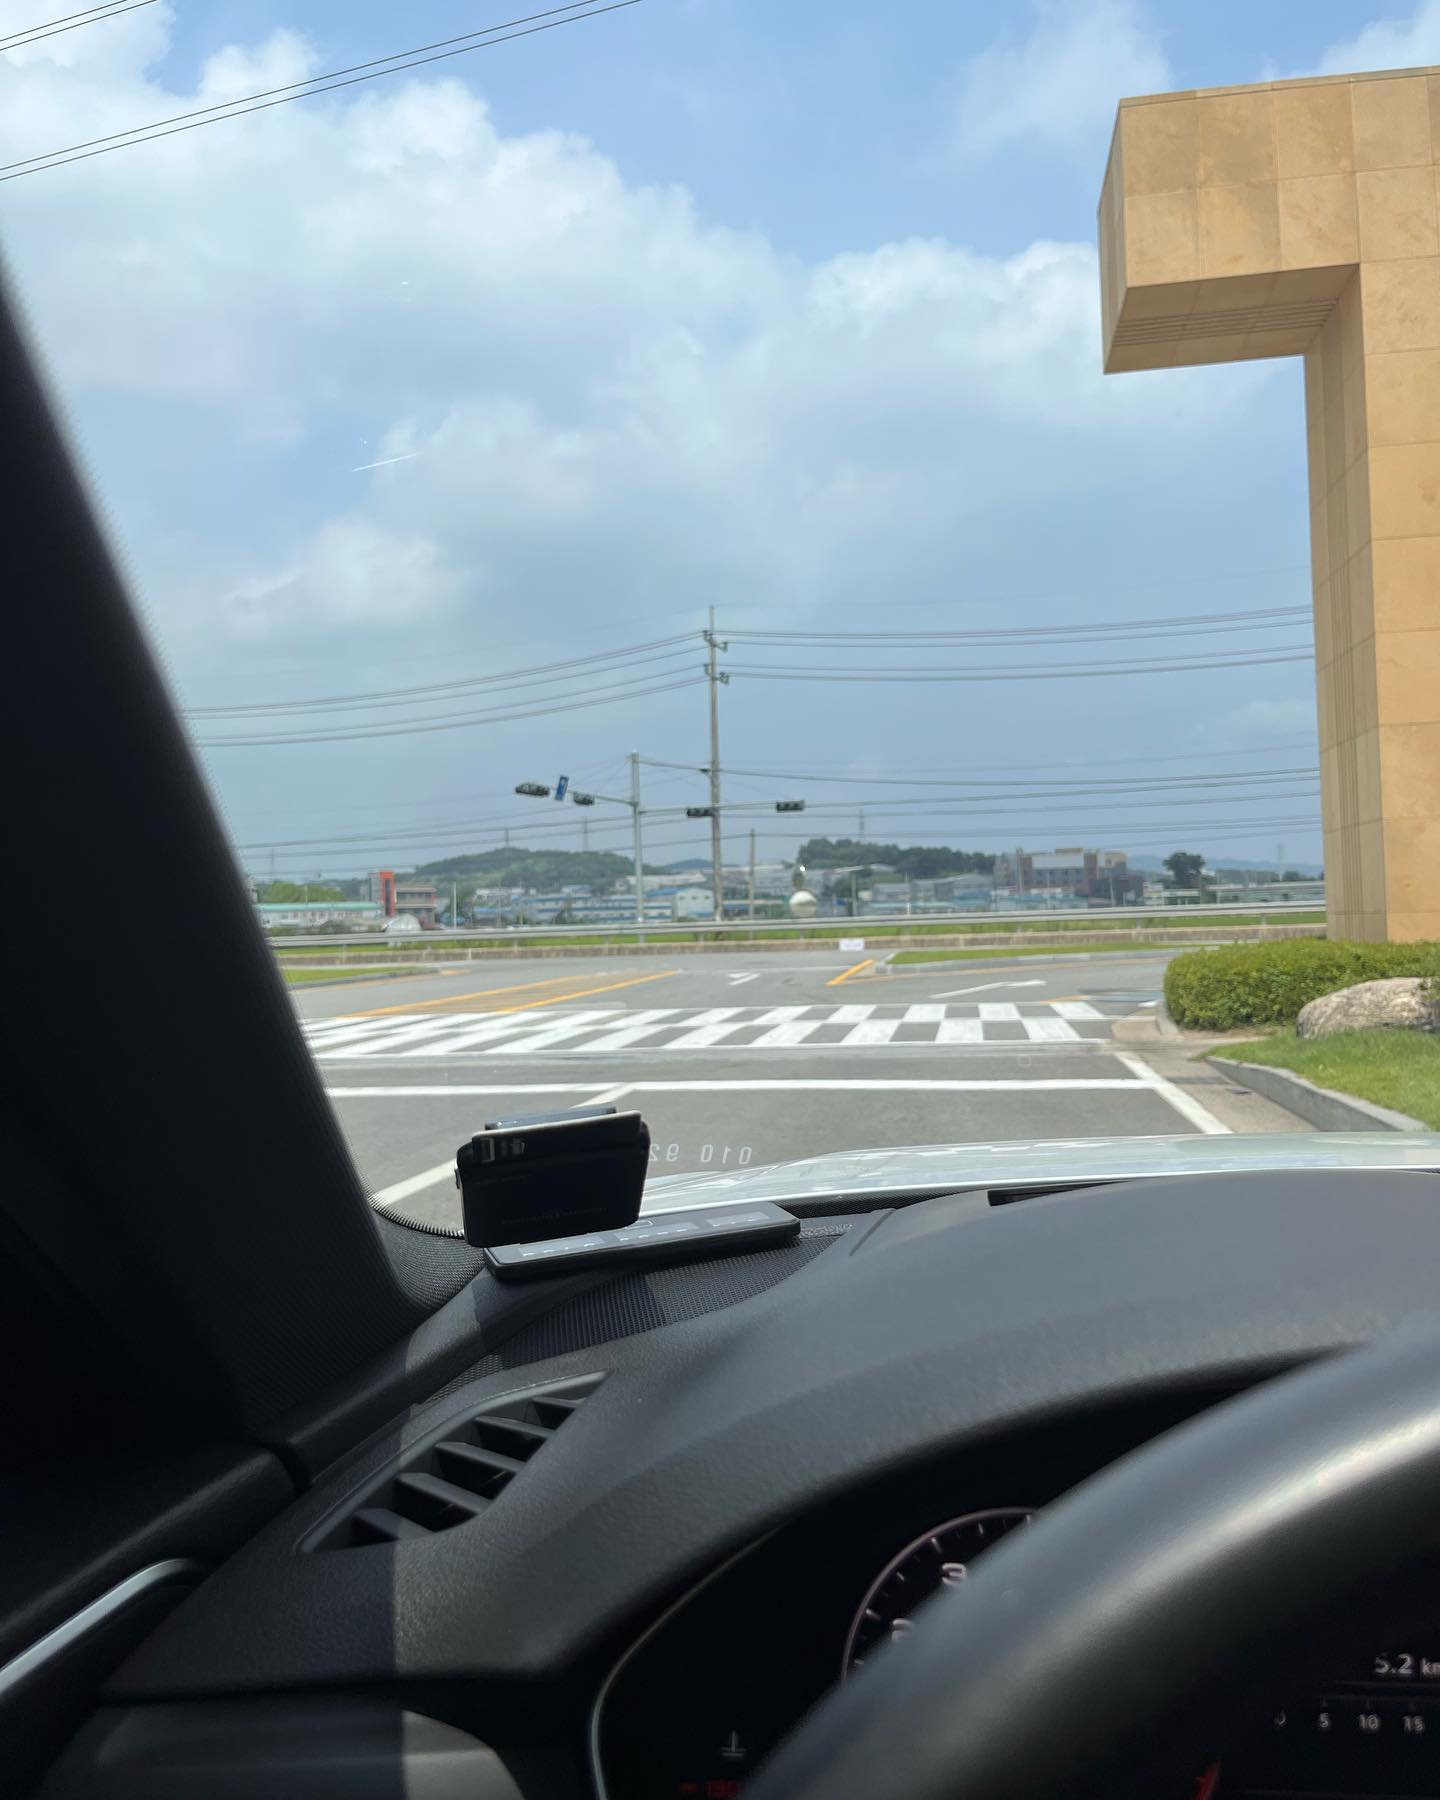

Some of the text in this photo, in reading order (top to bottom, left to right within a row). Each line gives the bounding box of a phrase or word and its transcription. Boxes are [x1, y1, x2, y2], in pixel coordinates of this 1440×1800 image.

[941, 1562, 967, 1587] 3
[1318, 1712, 1330, 1728] 5
[1358, 1714, 1379, 1730] 10
[1402, 1715, 1425, 1732] 15
